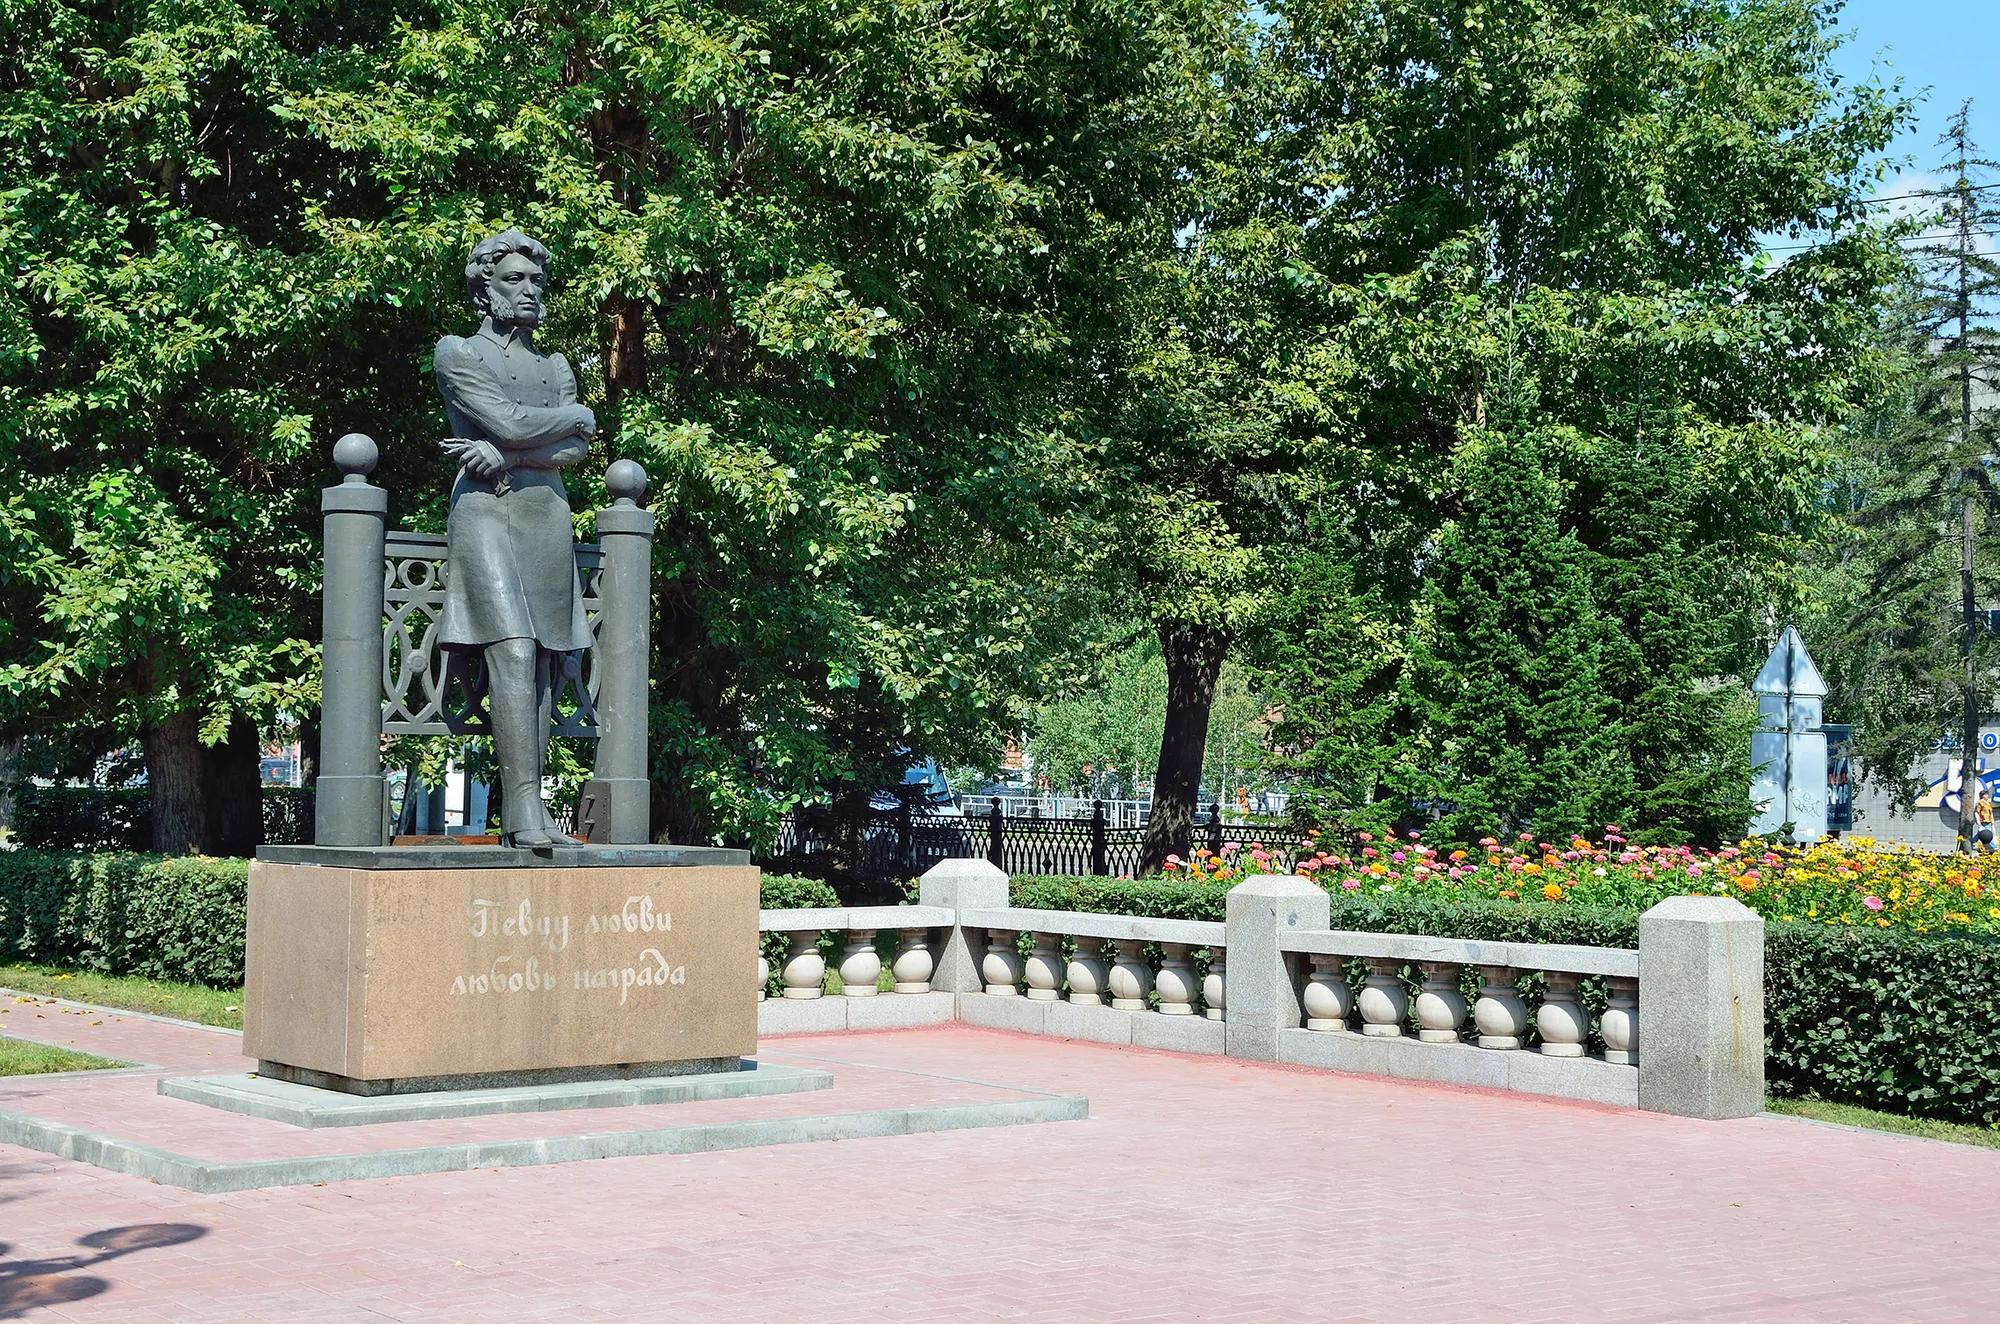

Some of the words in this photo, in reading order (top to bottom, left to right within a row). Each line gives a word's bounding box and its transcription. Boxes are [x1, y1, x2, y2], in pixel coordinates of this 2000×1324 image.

[471, 897, 569, 952] Певцу
[586, 895, 673, 933] любви
[449, 955, 558, 996] любовь
[574, 948, 687, 1006] награда
